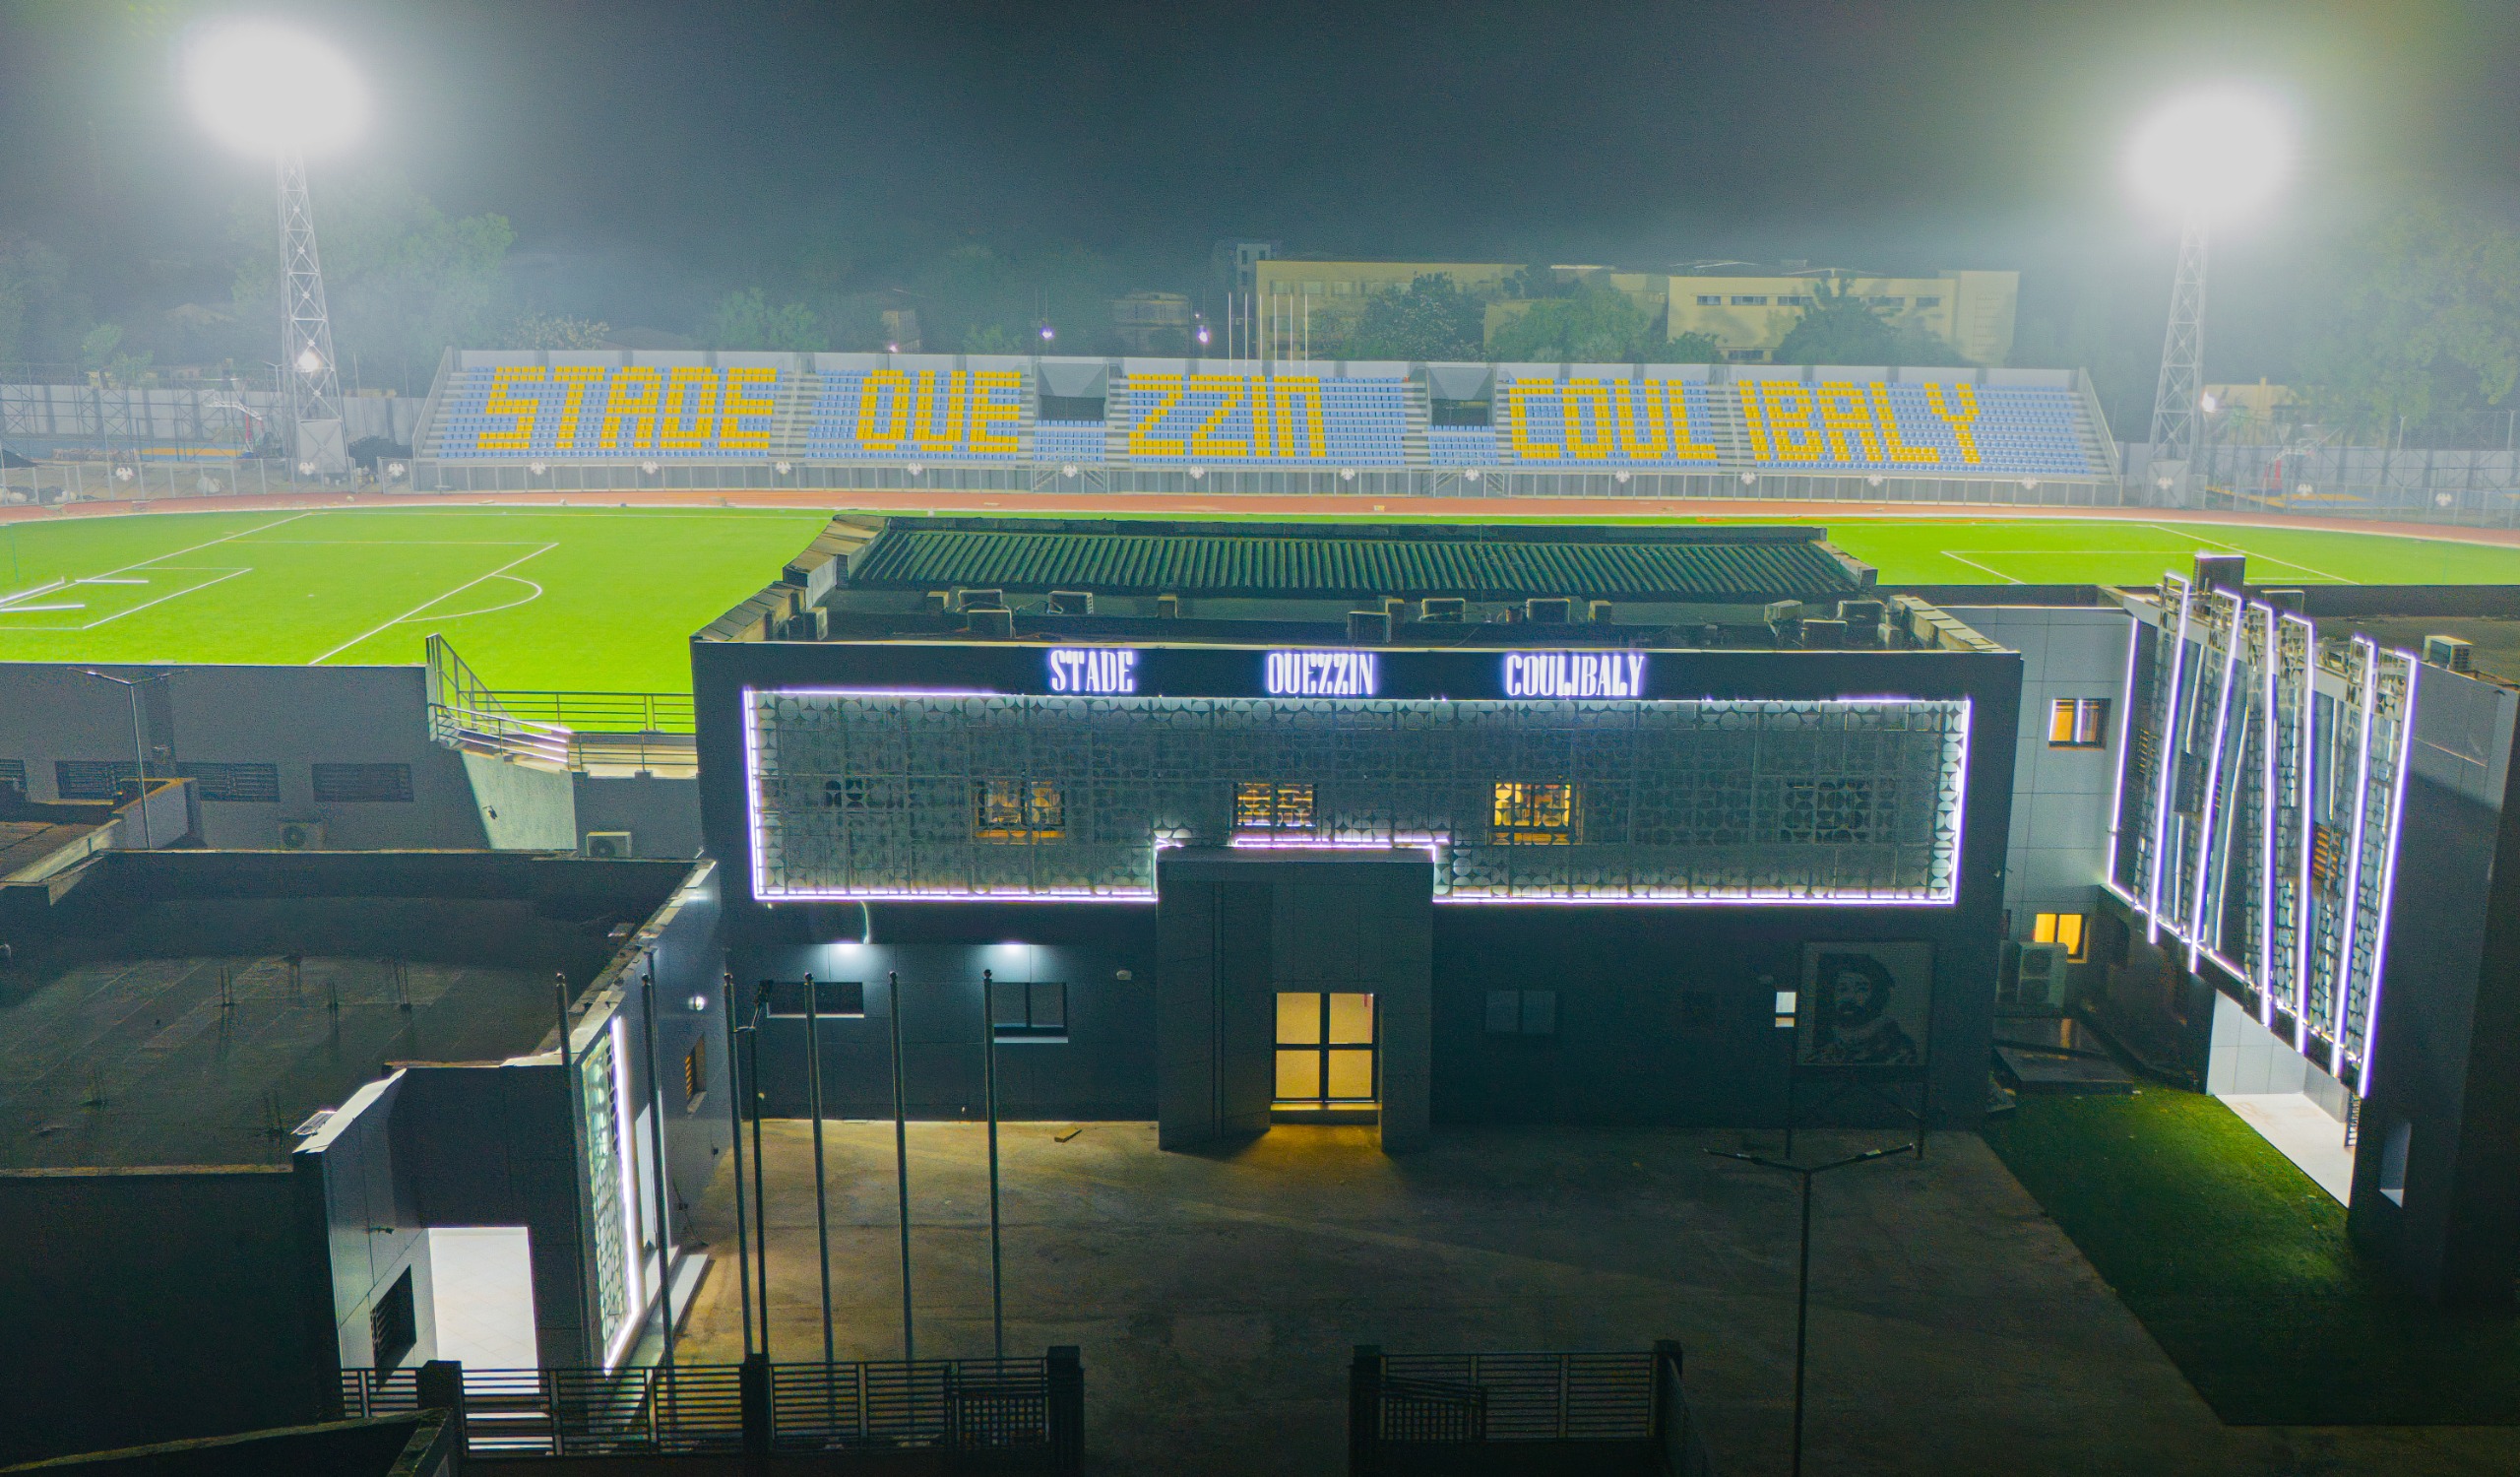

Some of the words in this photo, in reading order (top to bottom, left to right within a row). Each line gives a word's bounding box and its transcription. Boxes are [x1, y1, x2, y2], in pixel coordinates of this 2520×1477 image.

[478, 366, 776, 448] STADE
[856, 370, 1021, 452] OUE
[1129, 374, 1325, 457] ZZIN
[1509, 378, 1717, 459] COUL
[1738, 381, 1980, 463] IBALY
[1050, 650, 1134, 692] STADE
[1267, 653, 1374, 695] OUEZZIN
[1506, 654, 1645, 697] COULIBALY
